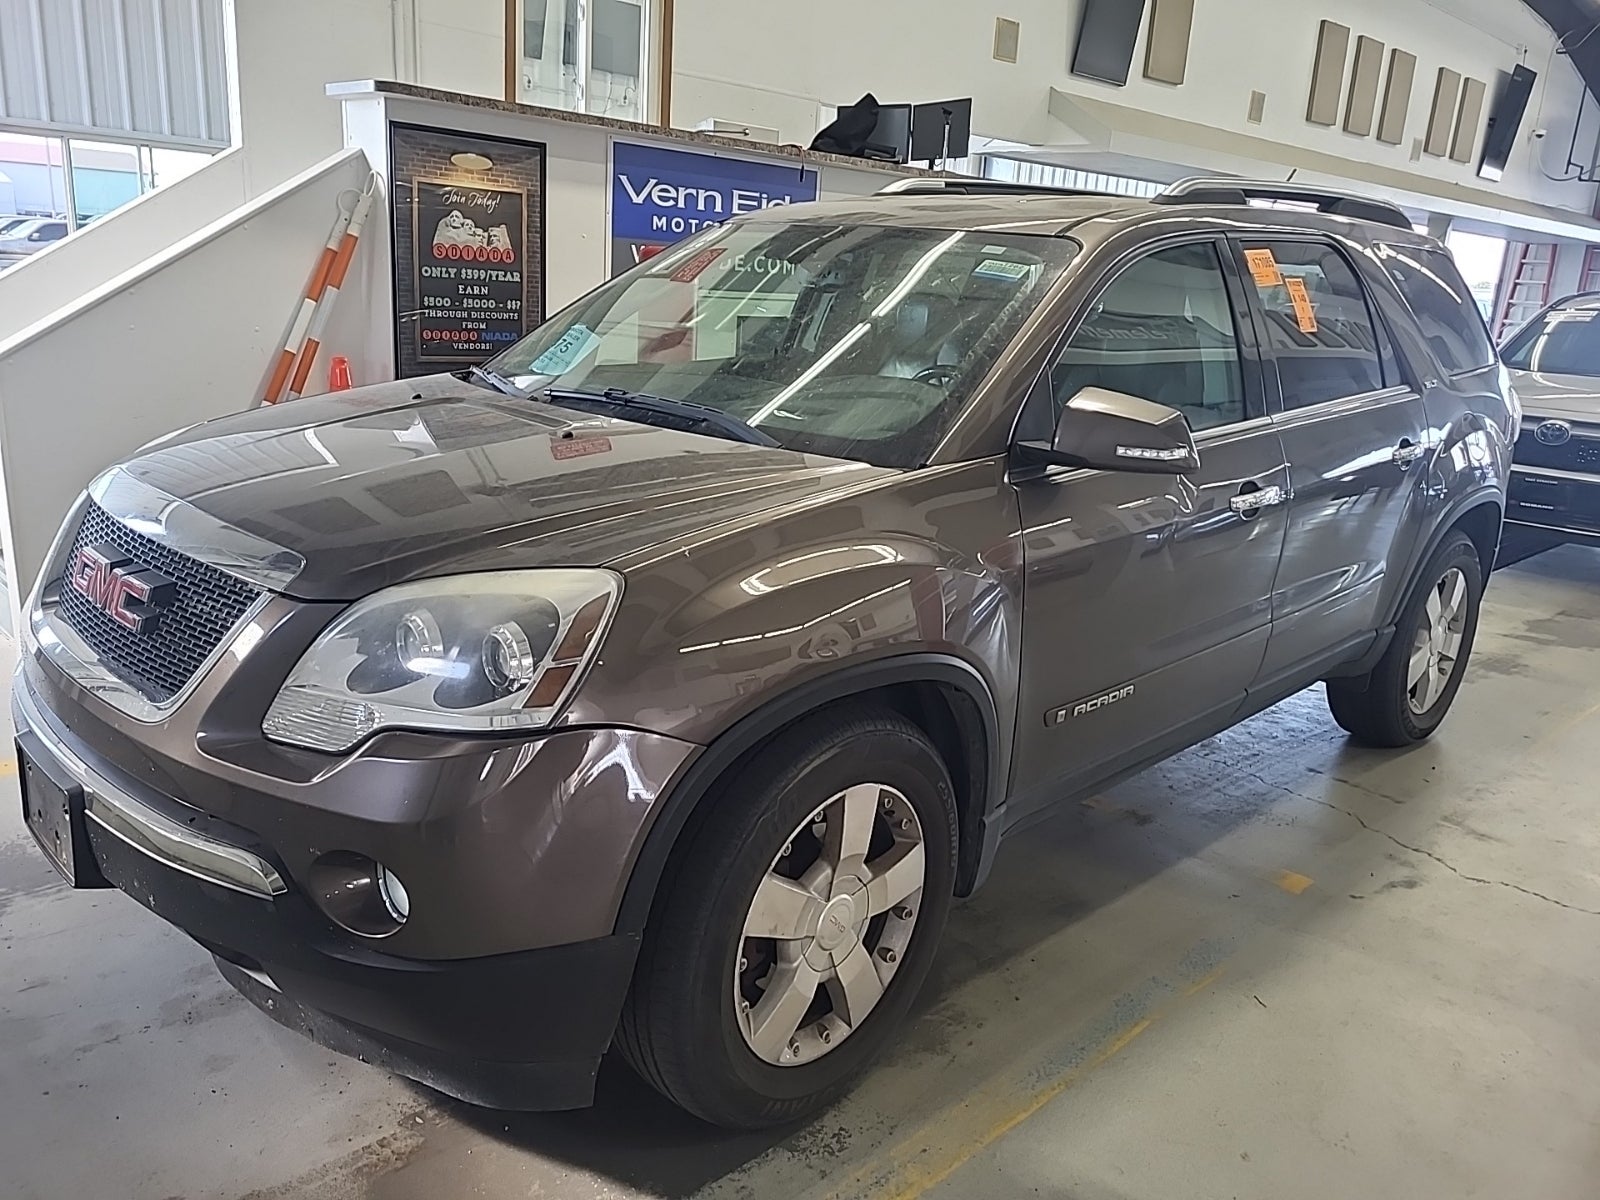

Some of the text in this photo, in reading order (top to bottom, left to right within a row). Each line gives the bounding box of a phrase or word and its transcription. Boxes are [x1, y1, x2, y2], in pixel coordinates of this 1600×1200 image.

[618, 174, 723, 213] Vern
[443, 187, 502, 214] Join Today!
[434, 244, 514, 262] SDIADA
[421, 266, 457, 278] ONLY
[458, 284, 489, 295] EARN
[424, 309, 519, 320] THROUGH DISCOUNTS
[462, 321, 487, 329] FROM
[481, 332, 519, 341] NIADA
[452, 342, 493, 350] VENDORS!
[73, 546, 152, 634] GMC
[1073, 684, 1135, 717] ACADIA
